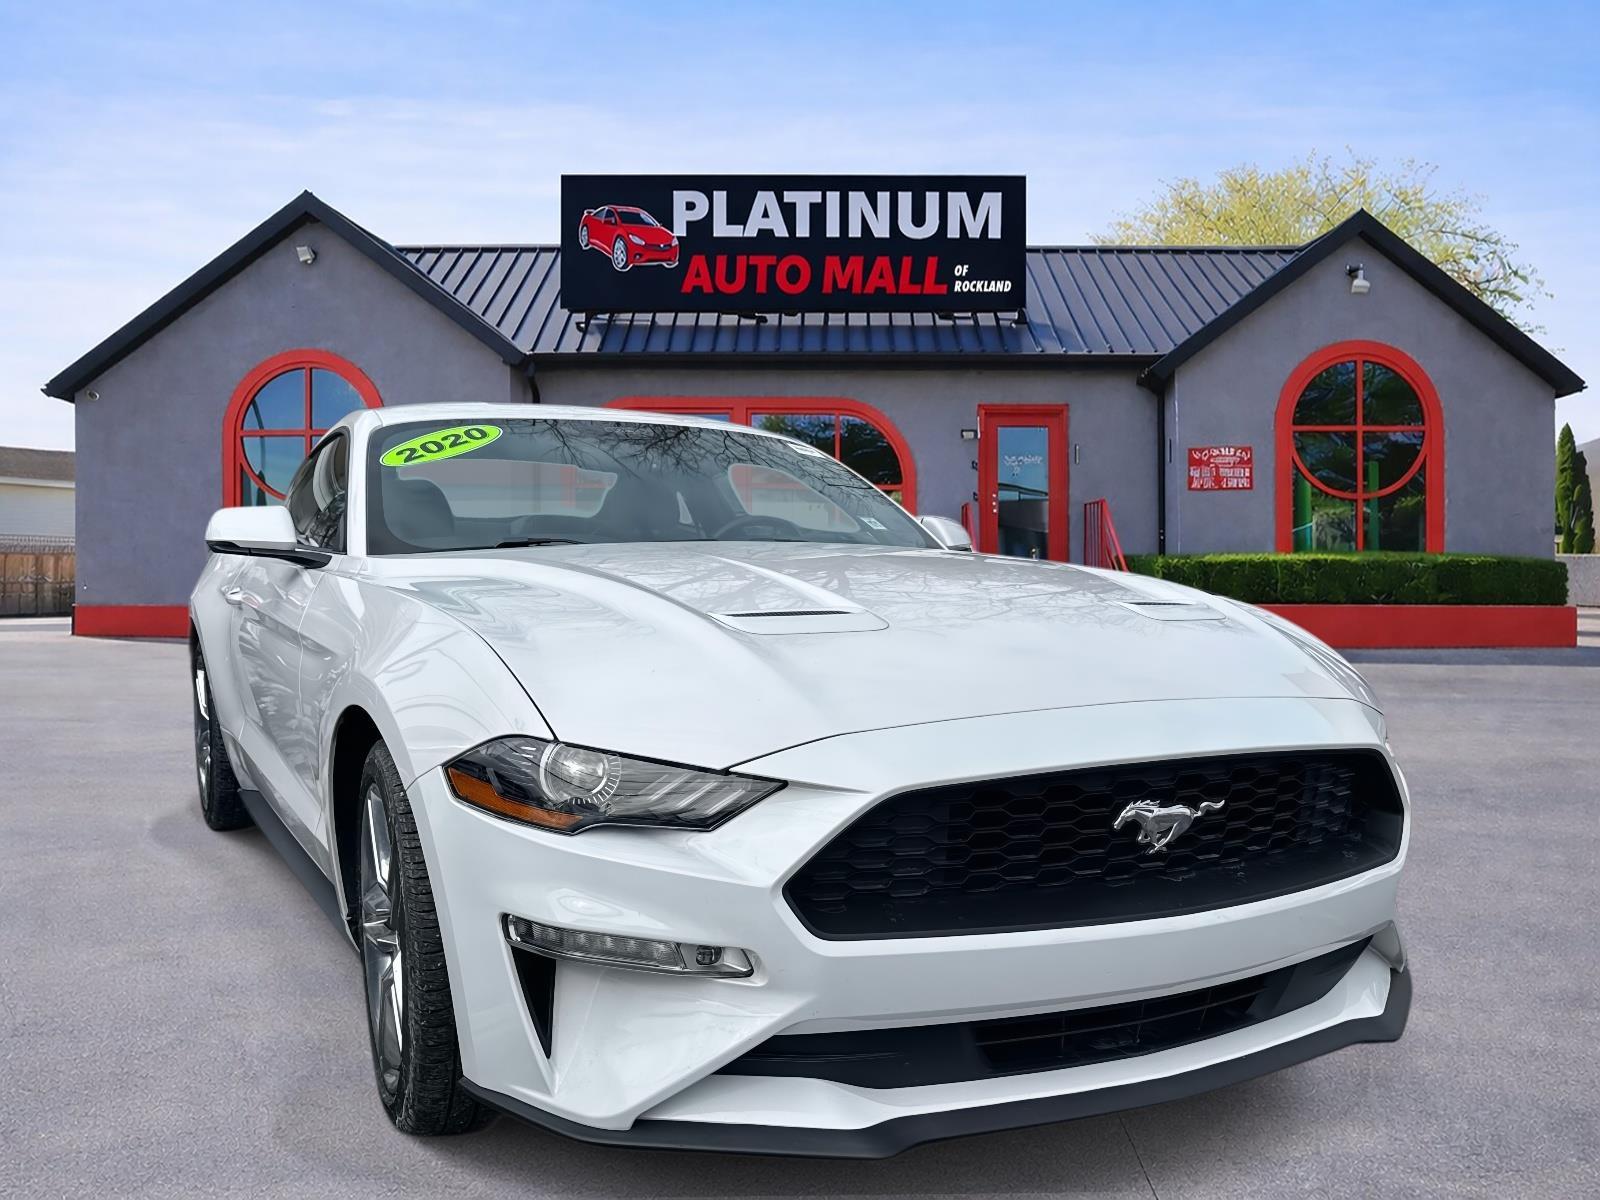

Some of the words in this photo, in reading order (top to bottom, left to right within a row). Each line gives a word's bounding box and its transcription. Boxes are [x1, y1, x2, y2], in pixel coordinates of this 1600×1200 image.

[673, 190, 1003, 240] PLATINUM
[681, 254, 812, 295] AUTO
[822, 255, 949, 295] MALL
[954, 264, 969, 277] OF
[954, 280, 1012, 292] ROCKLAND
[395, 427, 488, 463] 2020
